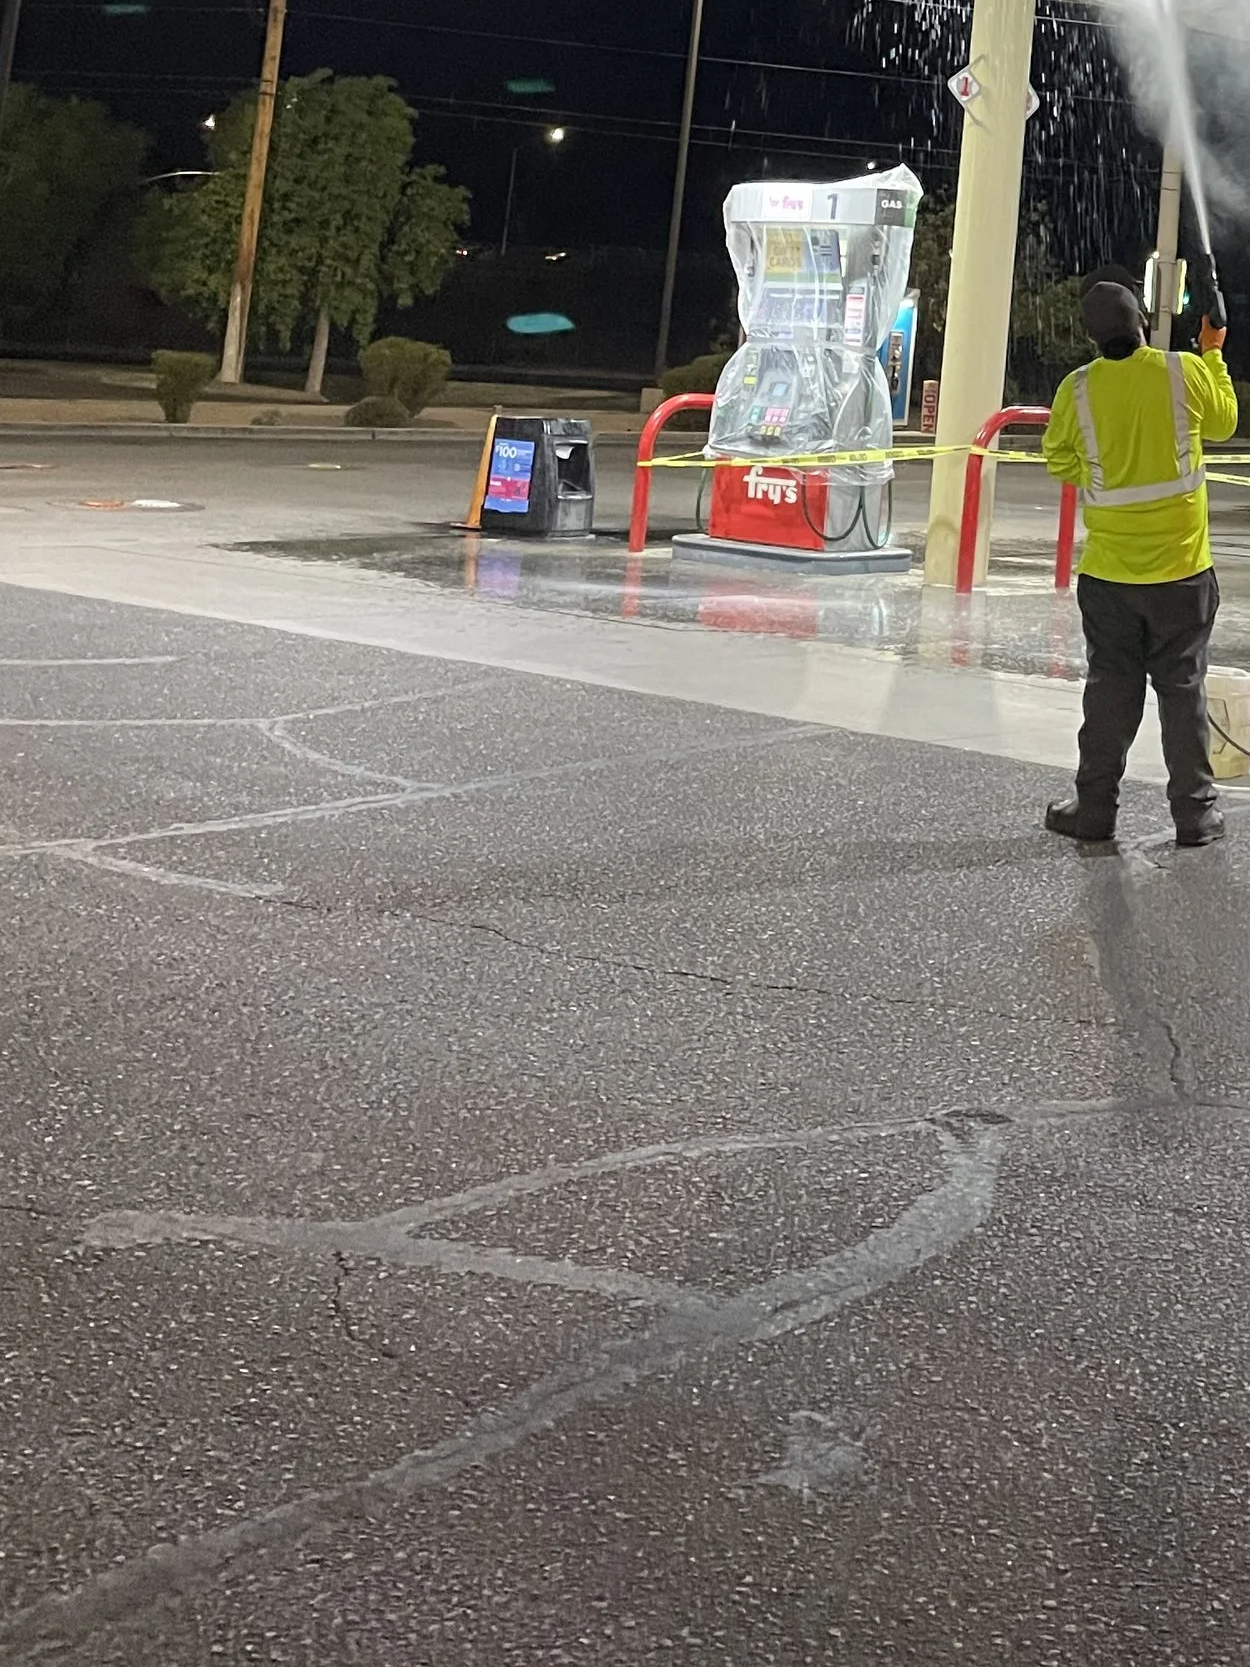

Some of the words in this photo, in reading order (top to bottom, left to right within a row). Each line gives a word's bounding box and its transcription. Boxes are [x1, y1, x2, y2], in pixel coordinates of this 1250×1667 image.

[827, 193, 839, 220] 1
[881, 199, 903, 209] GAS
[923, 394, 936, 433] OPEN
[743, 465, 798, 505] fry's
